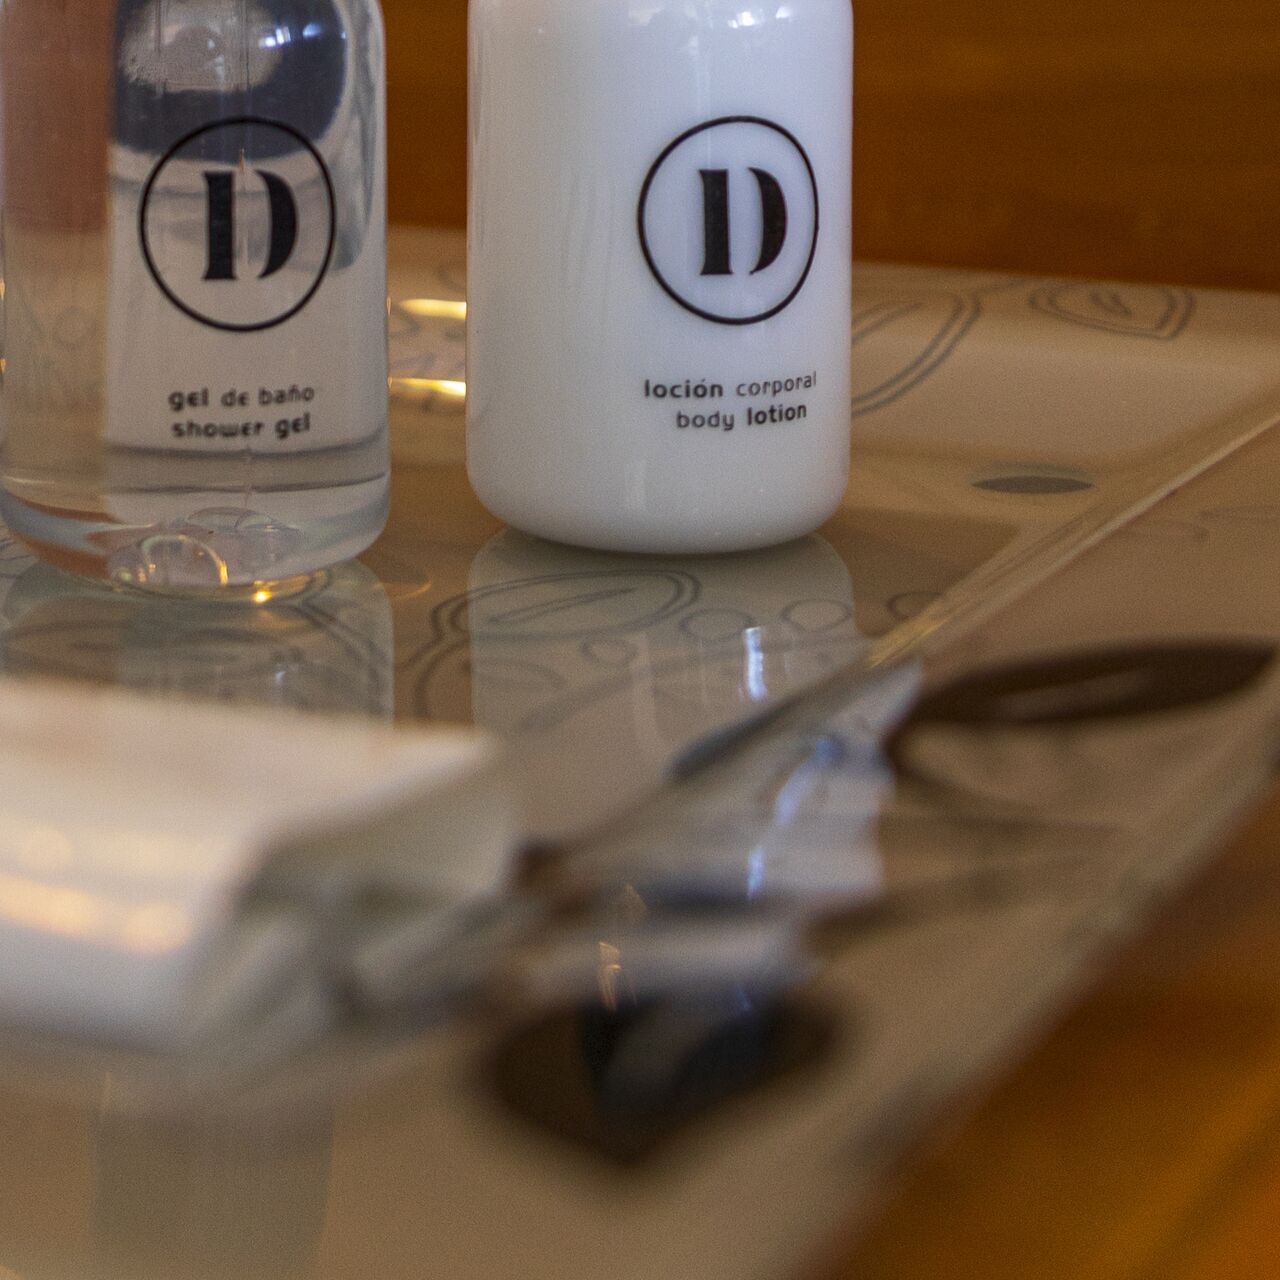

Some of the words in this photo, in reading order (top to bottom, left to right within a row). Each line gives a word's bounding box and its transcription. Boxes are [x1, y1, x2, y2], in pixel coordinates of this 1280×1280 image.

[168, 387, 209, 412] gel
[221, 388, 249, 407] de
[258, 384, 314, 406] baño
[644, 378, 724, 399] loción
[735, 371, 817, 398] corporal
[172, 420, 265, 438] shower
[275, 411, 311, 439] gel
[676, 410, 735, 431] body
[747, 403, 807, 426] lotion
